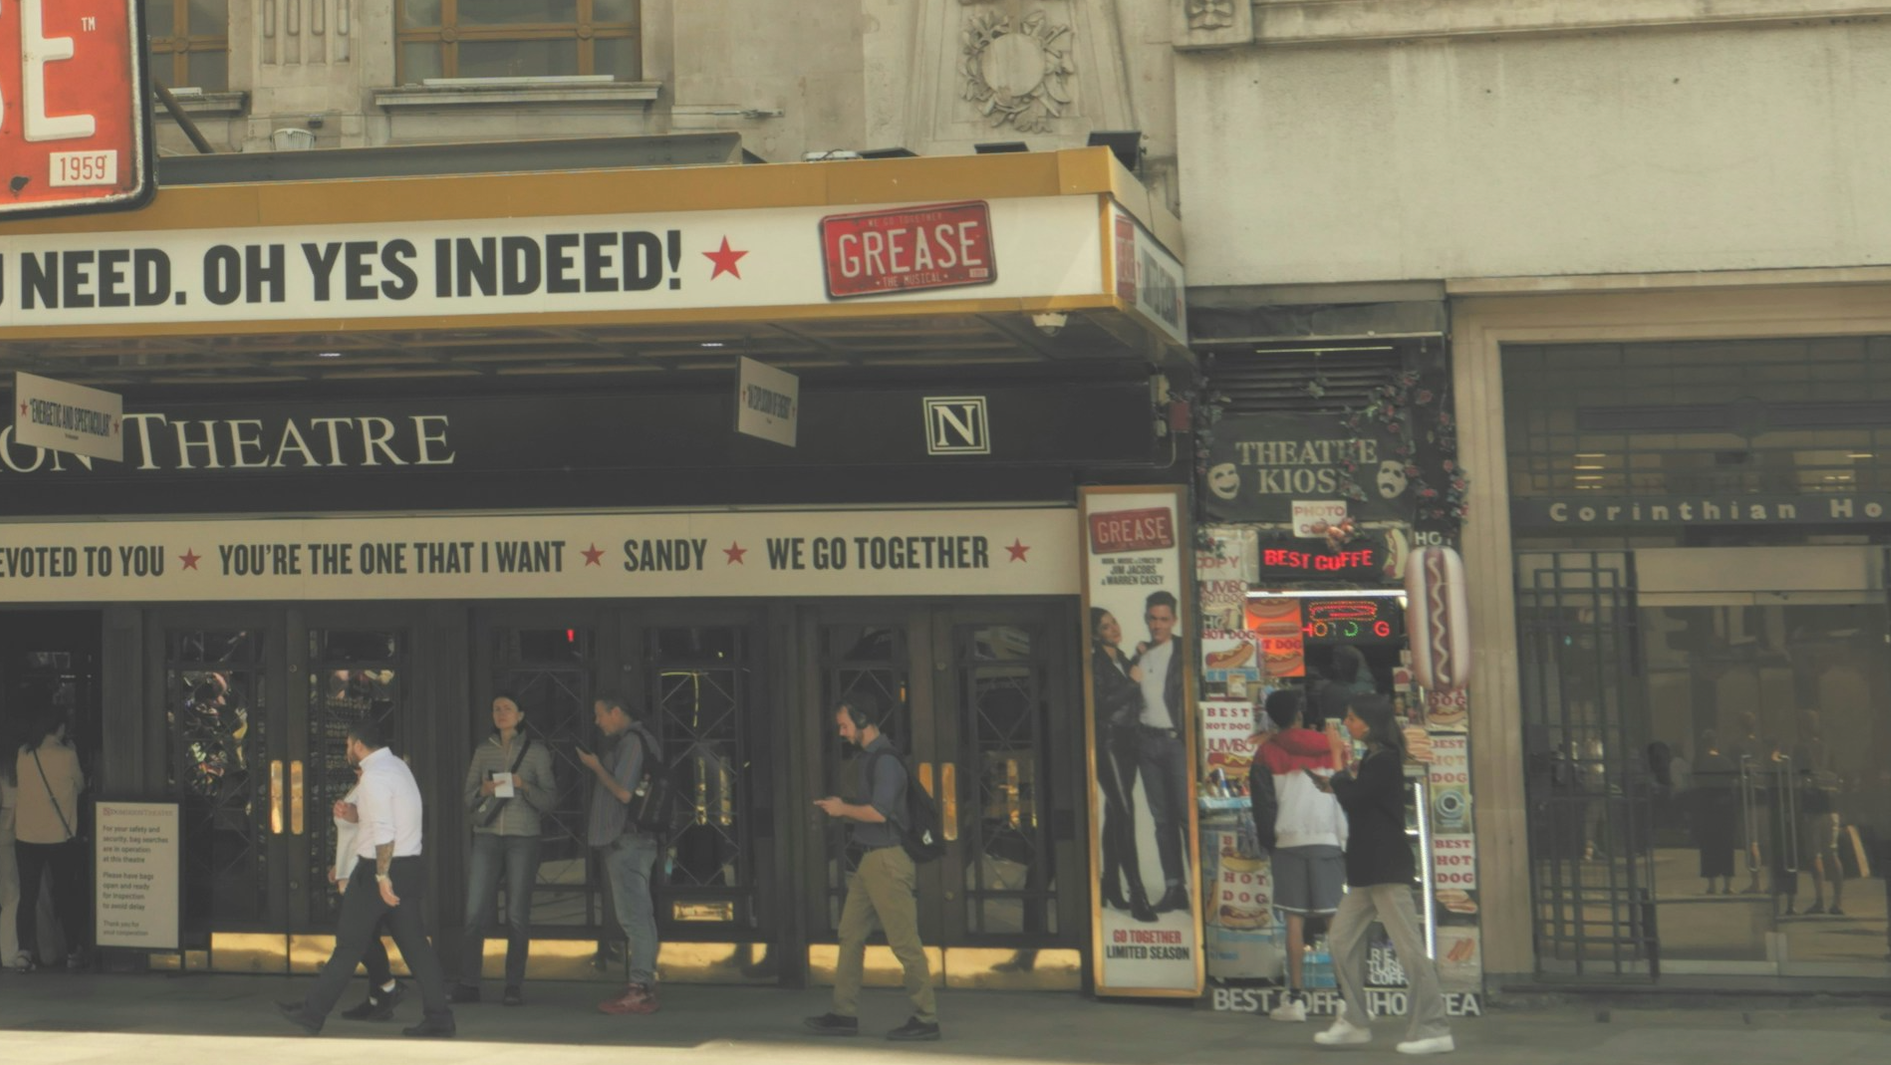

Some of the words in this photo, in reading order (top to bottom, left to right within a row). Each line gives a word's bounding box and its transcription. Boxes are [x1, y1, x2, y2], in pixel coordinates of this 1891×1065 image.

[59, 155, 107, 182] 1959
[838, 221, 982, 278] GREASE
[20, 247, 187, 310] NEED.
[202, 243, 287, 306] OH
[301, 237, 419, 303] YES
[435, 229, 683, 297] INDEED!
[933, 405, 976, 446] N
[121, 413, 457, 470] THEATRE
[1294, 506, 1345, 516] PHOTO
[1550, 500, 1796, 522] Corinthian
[1097, 516, 1167, 545] GREASE
[84, 545, 113, 577] TO
[119, 545, 165, 576] YOU
[219, 543, 302, 576] YOU'RE
[308, 543, 353, 575] THE
[359, 542, 407, 575] ONE
[414, 541, 476, 574] THAT
[480, 541, 490, 574] I
[495, 540, 566, 573] WANT
[623, 539, 707, 572] SANDY
[766, 537, 805, 570] WE
[812, 537, 847, 570] GO
[854, 536, 989, 569] TOGETHER
[1264, 550, 1312, 569] BEST
[1207, 708, 1249, 717] BEST
[1431, 773, 1468, 783] DOG
[1435, 840, 1471, 849] BEST
[1436, 856, 1472, 866] HOT
[1224, 872, 1267, 885] HOT
[1437, 873, 1473, 884] DOG
[1113, 929, 1127, 943] GO
[1130, 929, 1182, 944] TOGETHER
[1106, 946, 1147, 959] LIMITED
[1149, 946, 1190, 960] SEASON
[1213, 988, 1272, 1012] BEST
